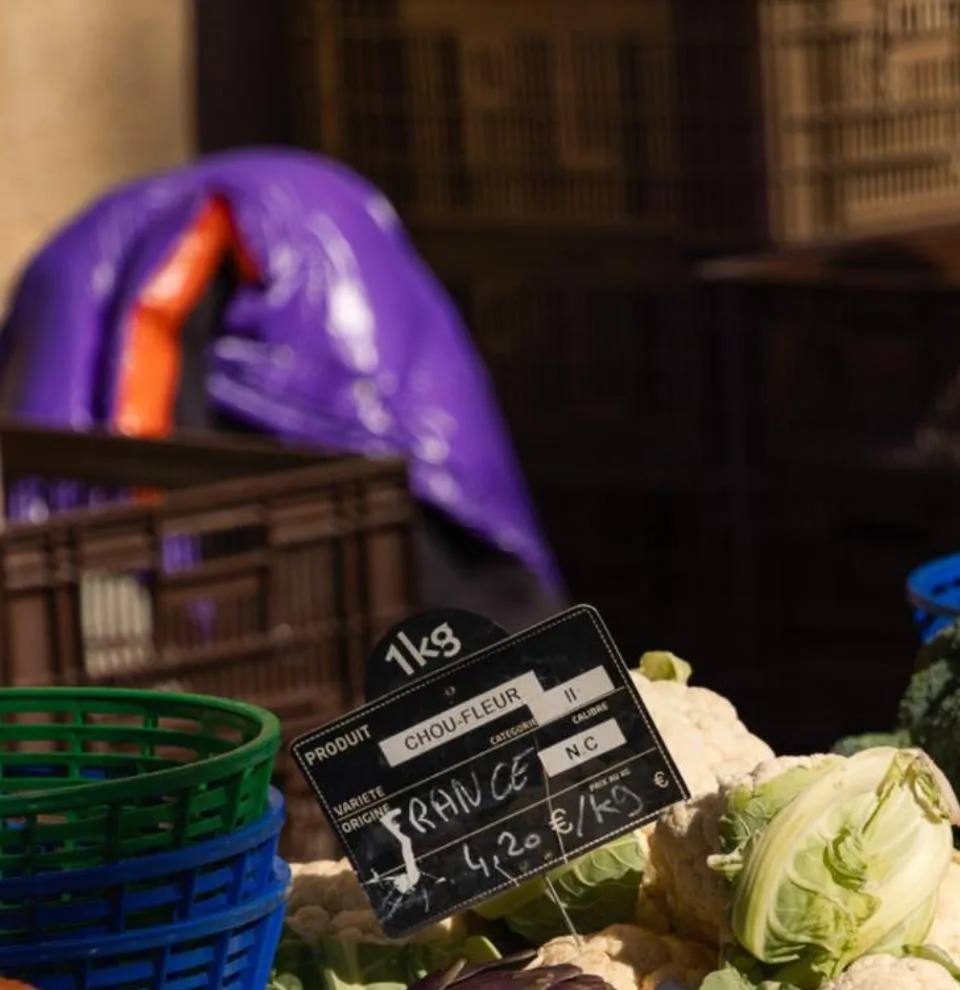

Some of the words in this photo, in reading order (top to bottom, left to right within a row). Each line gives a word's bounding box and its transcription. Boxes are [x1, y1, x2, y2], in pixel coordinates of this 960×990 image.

[384, 621, 463, 677] 1kg
[563, 687, 579, 704] II
[571, 702, 610, 726] CALIBRE
[403, 686, 523, 752] CHOU-FLEUR
[304, 723, 373, 767] PRODUIT
[565, 735, 600, 762] N.C
[333, 785, 387, 818] VARIETE
[378, 746, 534, 852] FRANCE
[341, 802, 394, 835] ORIGINE
[462, 830, 542, 878] 4,20
